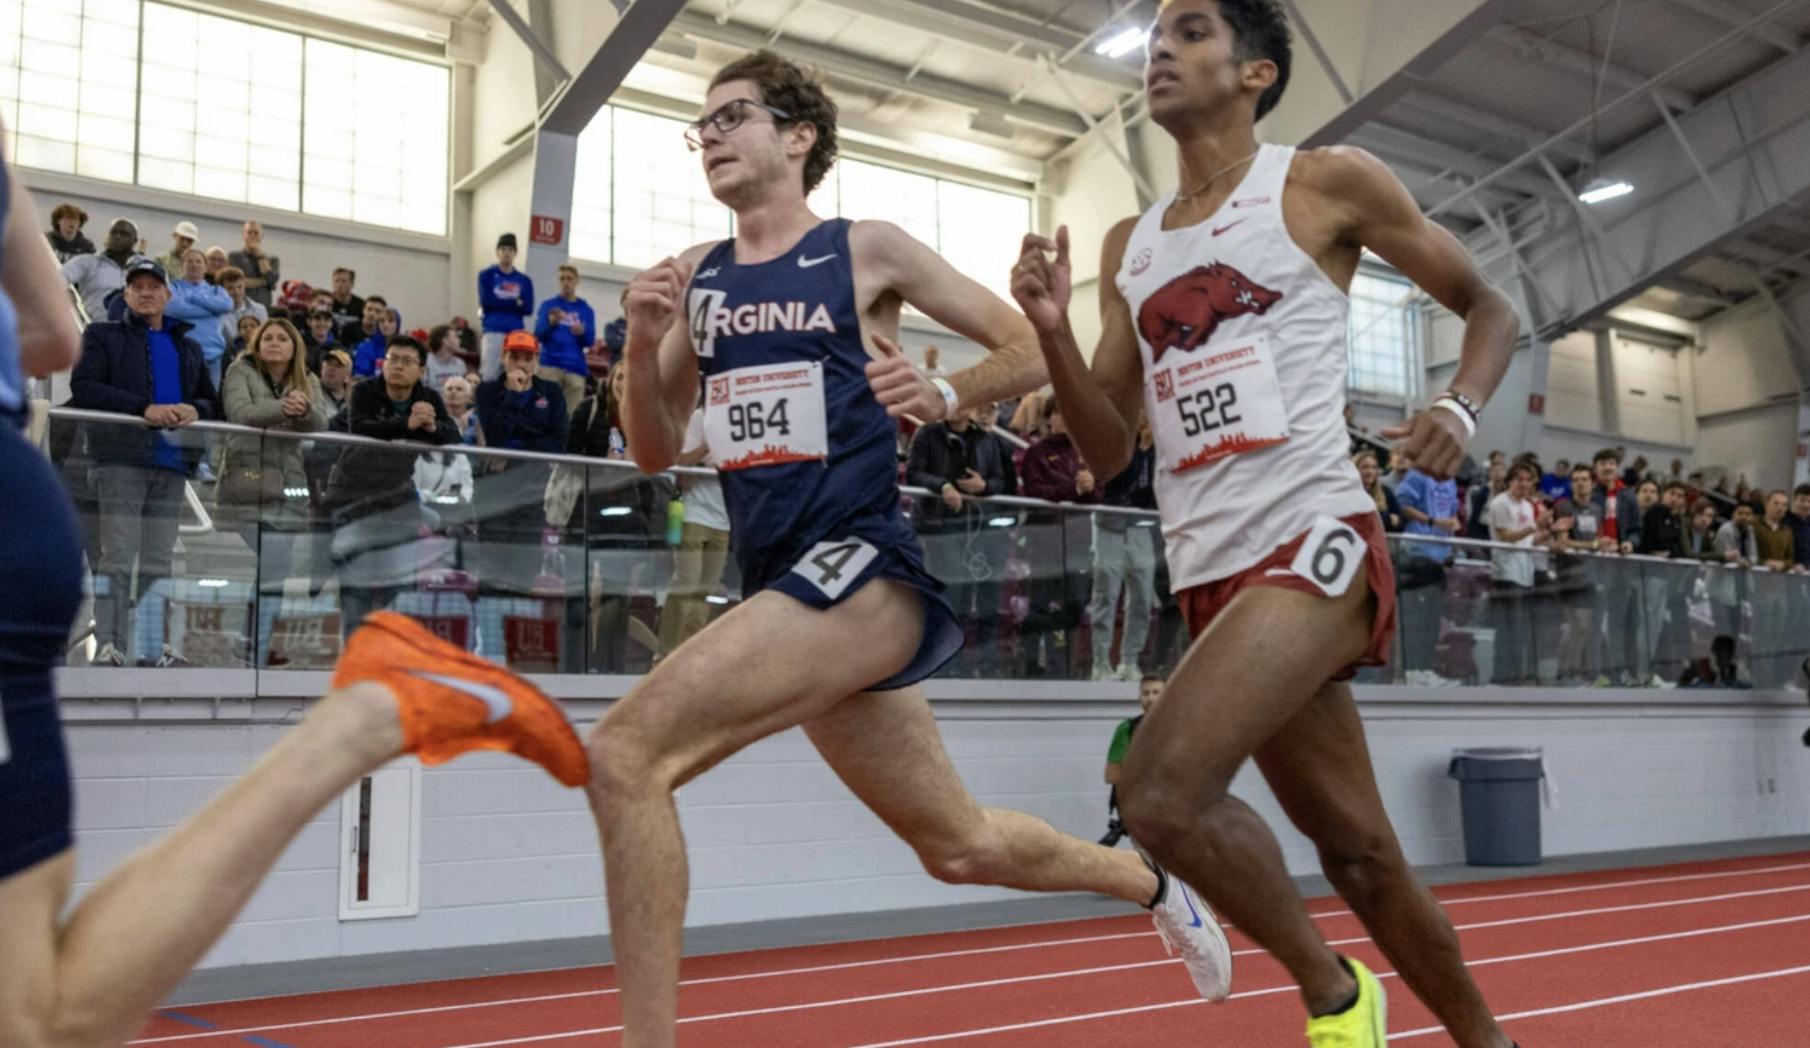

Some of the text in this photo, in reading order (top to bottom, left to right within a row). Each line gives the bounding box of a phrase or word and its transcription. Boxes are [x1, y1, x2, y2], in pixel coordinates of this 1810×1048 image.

[539, 219, 555, 236] 10
[692, 293, 713, 353] 4
[713, 302, 837, 337] RGINIA
[728, 398, 790, 442] 964
[1176, 382, 1242, 438] 522
[811, 542, 864, 586] 4
[1311, 528, 1355, 586] 6
